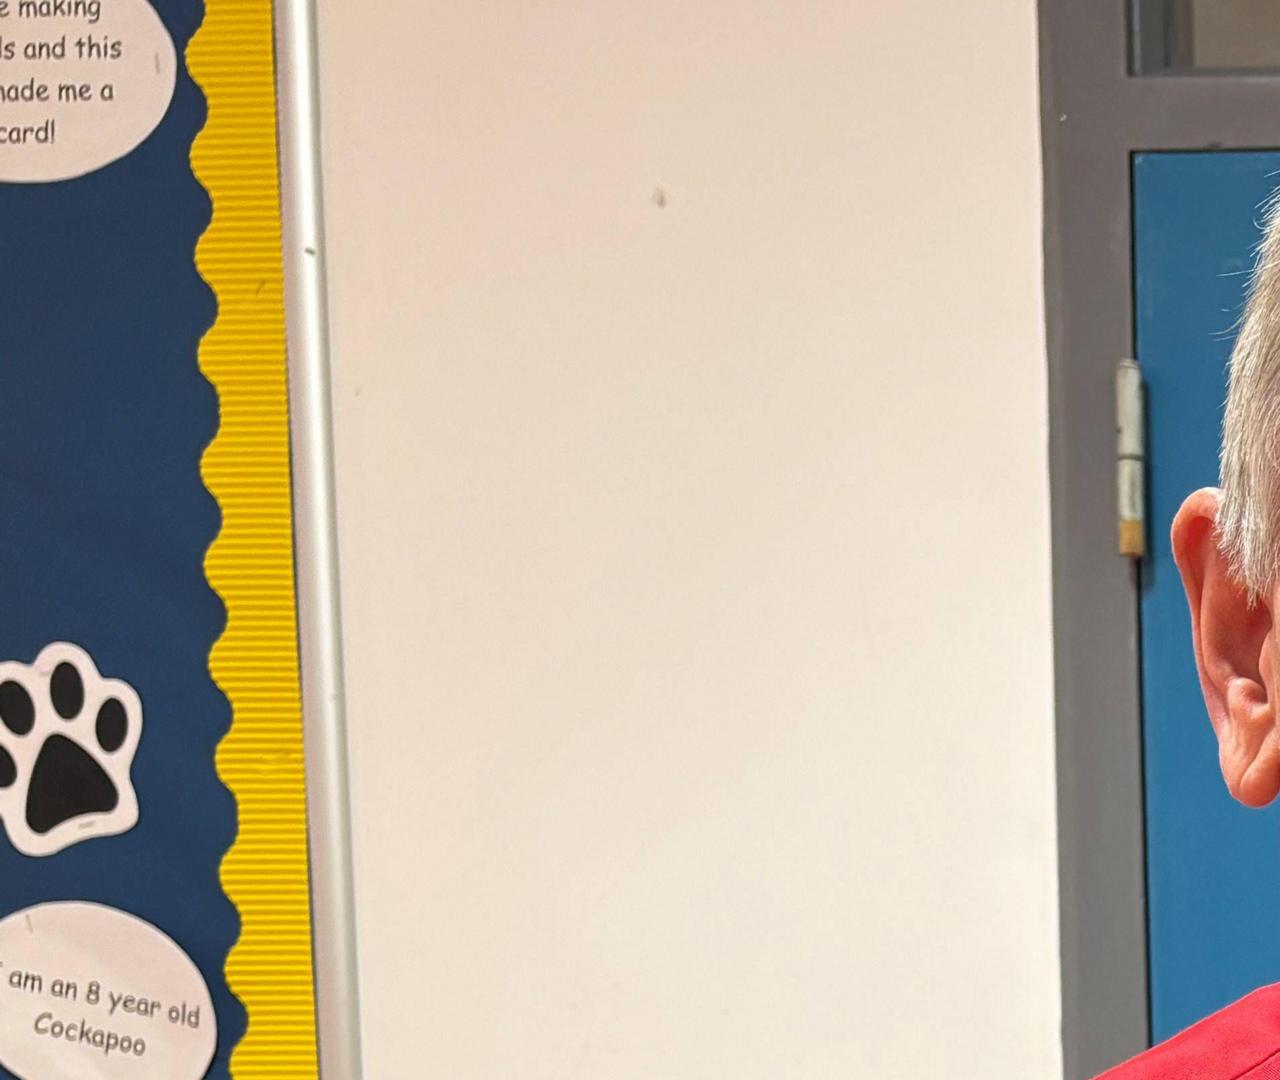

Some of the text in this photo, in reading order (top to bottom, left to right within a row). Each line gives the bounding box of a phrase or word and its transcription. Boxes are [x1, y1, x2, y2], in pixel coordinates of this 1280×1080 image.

[18, 0, 101, 24] making
[0, 34, 123, 60] s and this
[58, 83, 92, 102] me
[100, 84, 114, 102] a
[8, 970, 200, 1029] am an 8 year old
[33, 1012, 147, 1056] Cockapoo
